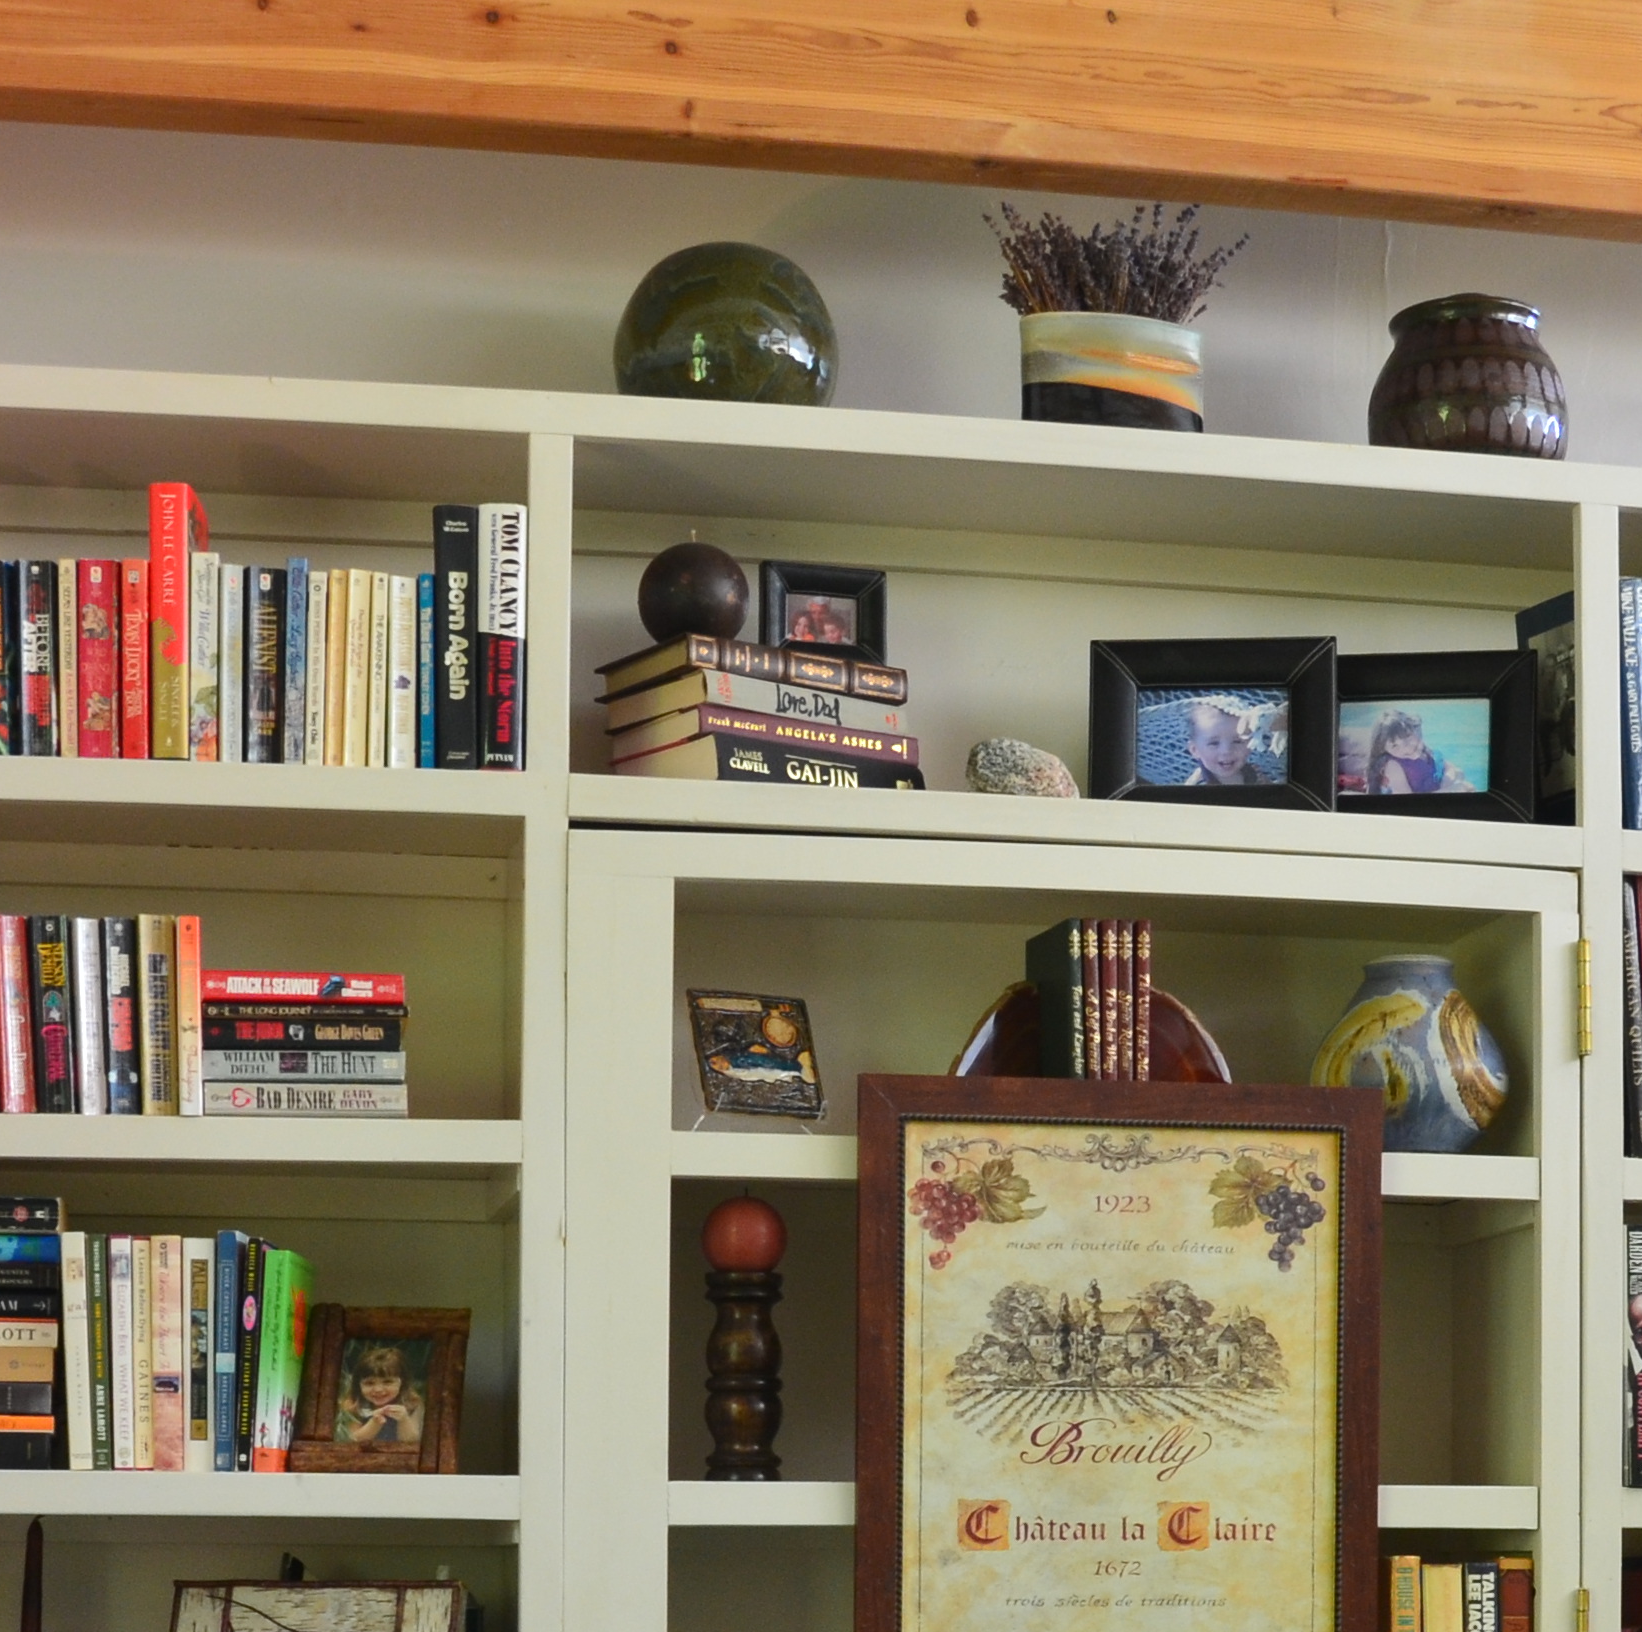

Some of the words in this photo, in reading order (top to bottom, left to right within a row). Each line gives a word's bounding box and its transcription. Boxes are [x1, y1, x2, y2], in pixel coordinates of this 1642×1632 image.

[160, 493, 177, 528] JOHN
[162, 535, 176, 547] LE
[499, 513, 519, 552] TOM
[161, 552, 178, 607] CARRÉ
[500, 557, 521, 632] CLANCY
[448, 572, 468, 629] Born
[446, 635, 470, 699] Again
[775, 725, 837, 744] ANGELA'S
[841, 734, 882, 752] ASHES
[786, 760, 858, 789] GAI-JIN
[1094, 1195, 1150, 1213] 1923
[1046, 1241, 1063, 1252] en
[1147, 1239, 1166, 1254] du
[1172, 1238, 1236, 1255] château
[1020, 1419, 1213, 1481] Brouilly
[964, 1506, 1106, 1546] Château
[1121, 1517, 1145, 1541] la
[1167, 1506, 1276, 1546] Claire
[1094, 1561, 1142, 1577] 1672
[1006, 1595, 1045, 1609] trois
[1056, 1594, 1110, 1609] siècles
[1116, 1596, 1133, 1608] de
[1141, 1594, 1226, 1609] traditions
[1468, 1573, 1481, 1600] LEE
